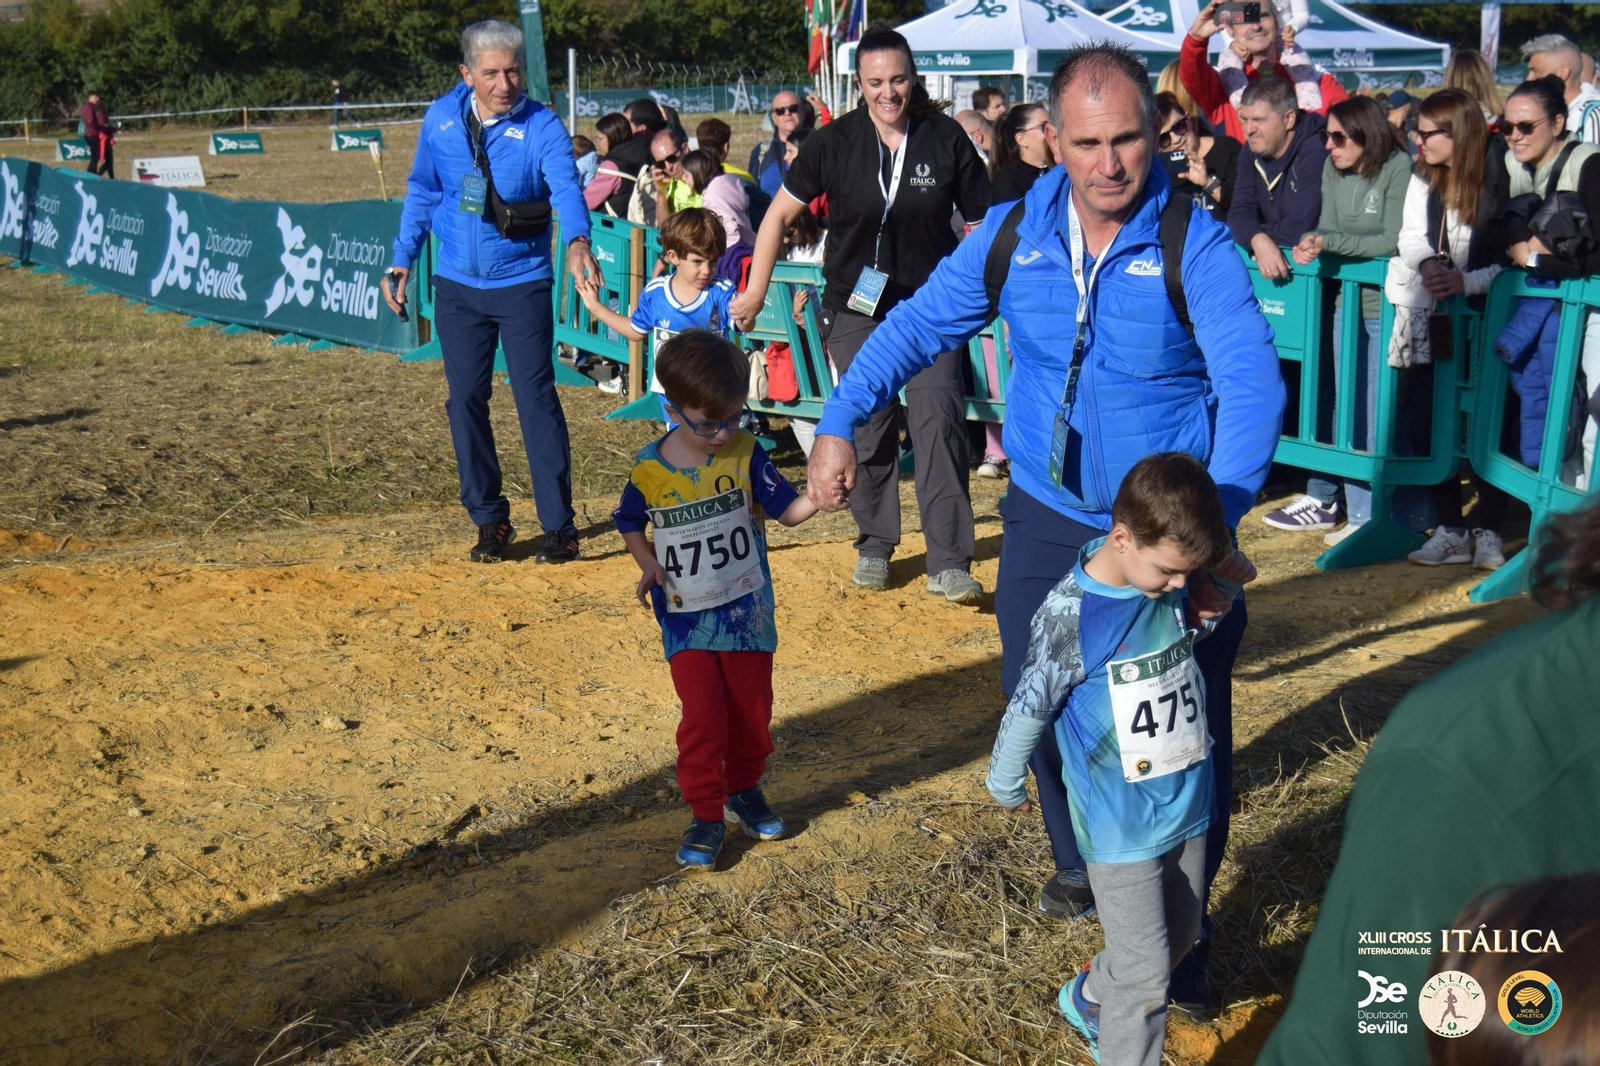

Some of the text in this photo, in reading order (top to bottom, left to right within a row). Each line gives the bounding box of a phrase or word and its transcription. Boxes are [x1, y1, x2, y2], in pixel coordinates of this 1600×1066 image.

[937, 53, 970, 66] Sevilla
[1333, 48, 1374, 67] Sevilla
[683, 101, 714, 113] Sevilla
[910, 176, 936, 184] ITÁLICA
[25, 213, 59, 250] Sevilla
[107, 207, 145, 237] Diputación
[100, 235, 138, 277] Sevilla
[205, 227, 253, 258] Diputación
[327, 233, 385, 267] Diputación
[196, 258, 247, 301] Sevilla
[321, 267, 380, 320] Sevilla
[1263, 304, 1284, 315] Sevilla
[669, 502, 723, 524] ITÁLICA
[665, 526, 750, 578] 4750
[1147, 645, 1186, 674] ITÁLICA
